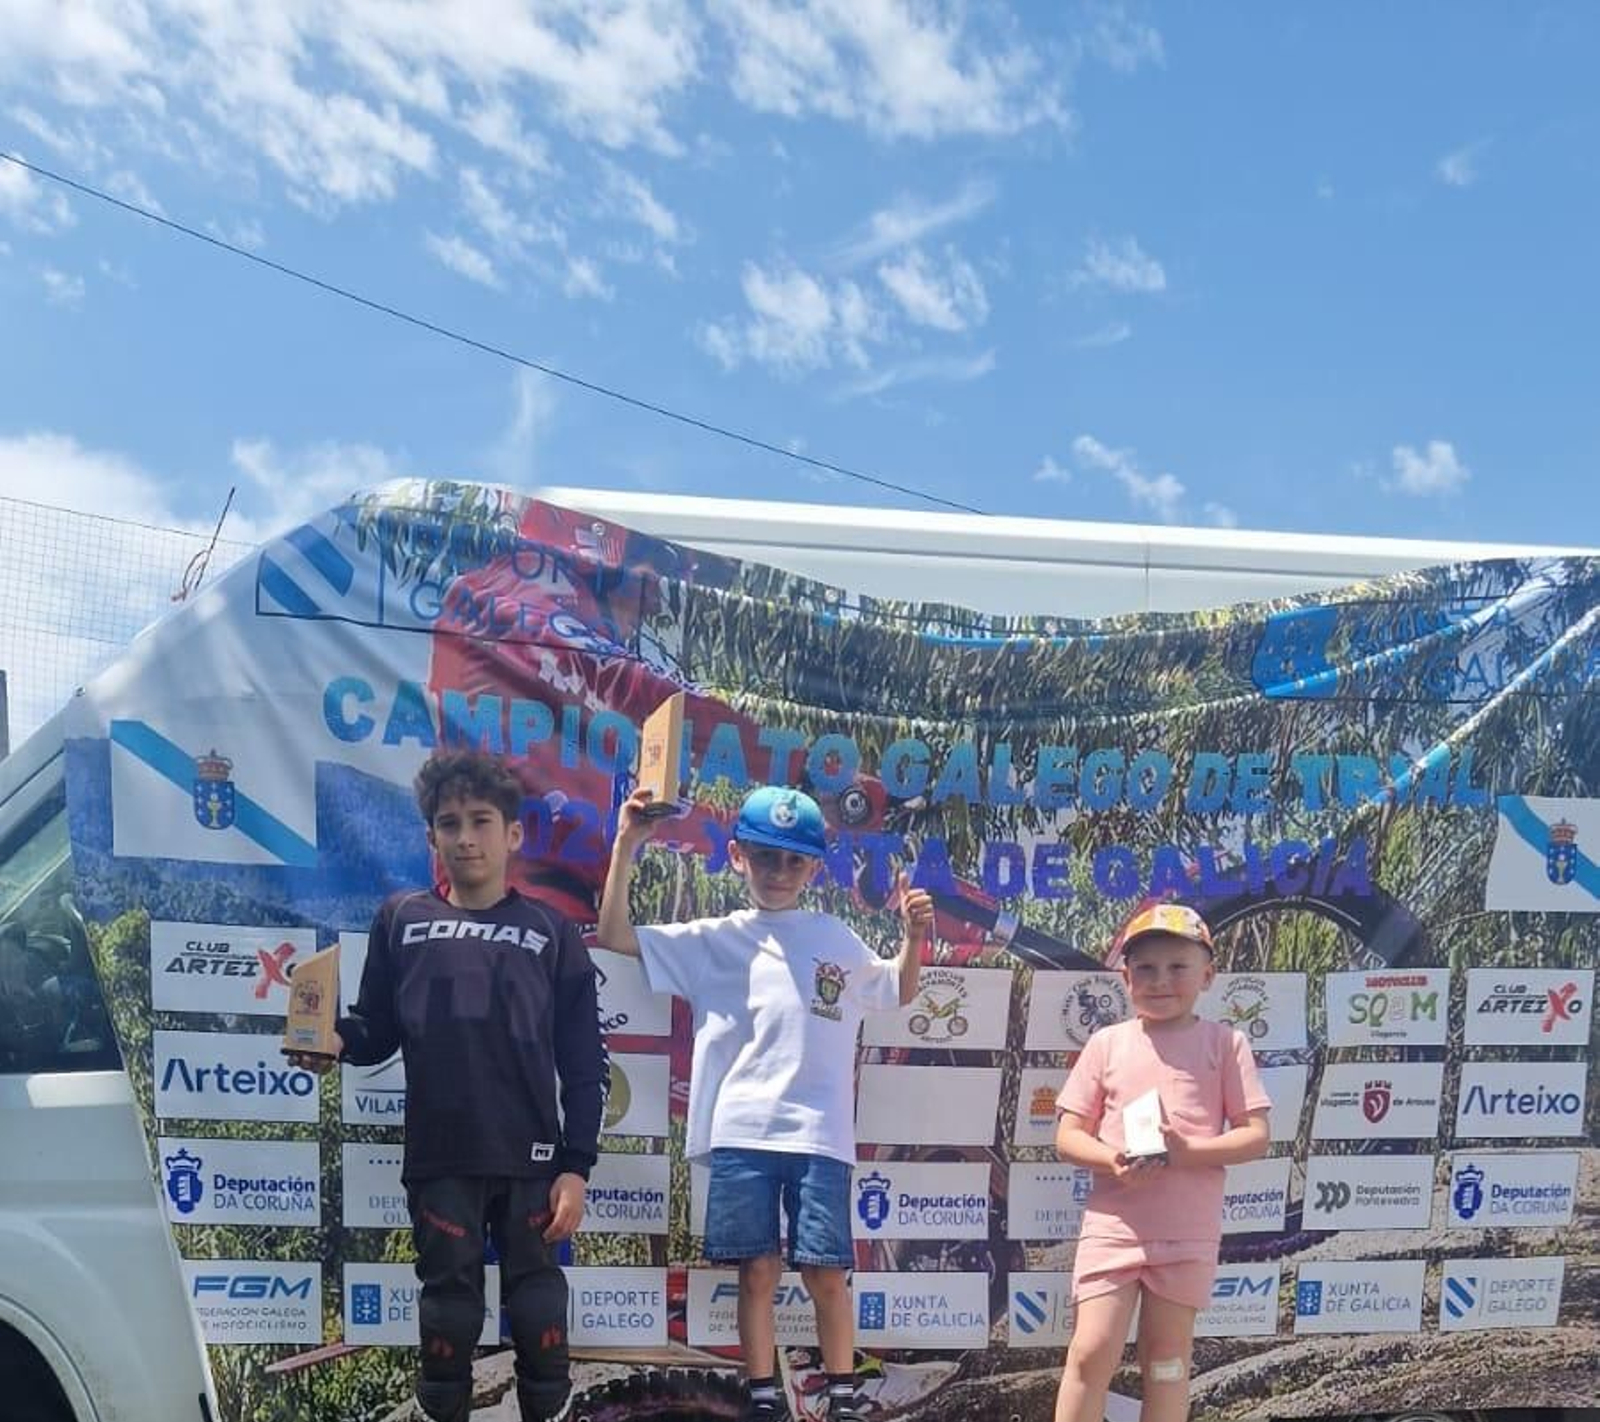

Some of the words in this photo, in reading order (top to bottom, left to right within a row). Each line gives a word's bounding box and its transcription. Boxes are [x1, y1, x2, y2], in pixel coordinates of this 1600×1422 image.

[881, 737, 1172, 810] GALEGO
[1190, 751, 1277, 812] DE
[981, 840, 1073, 899] DE
[1092, 837, 1374, 899] GALICIA
[402, 919, 550, 955] COMAS
[185, 941, 230, 953] CLUB
[1493, 984, 1528, 994] CLUB
[1477, 982, 1583, 1033] ARTEIXO
[161, 1058, 314, 1097] Arteixo
[1463, 1085, 1581, 1115] Arteixo
[213, 1174, 316, 1195] Deputación
[1491, 1183, 1571, 1200] Deputación
[214, 1194, 239, 1210] DA
[243, 1192, 316, 1212] CORUÑA
[585, 1187, 664, 1204] eputación
[898, 1193, 986, 1212] Deputación
[1224, 1190, 1284, 1208] eputación
[596, 1202, 663, 1220] CORUÑA
[899, 1211, 919, 1225] DA
[923, 1208, 986, 1226] CORUÑA
[193, 1275, 312, 1299] FGM
[1211, 1276, 1273, 1297] GM
[1327, 1281, 1380, 1297] XUNTA
[1490, 1278, 1556, 1295] DEPORTE
[581, 1291, 660, 1307] DEPORTE
[892, 1295, 948, 1310] XUNTA
[1325, 1299, 1347, 1313] DE
[1350, 1297, 1412, 1312] GALICIA
[1487, 1297, 1547, 1313] GALEGO
[581, 1313, 655, 1330] GALEGO
[891, 1313, 914, 1328] DE
[917, 1312, 985, 1328] GALICIA
